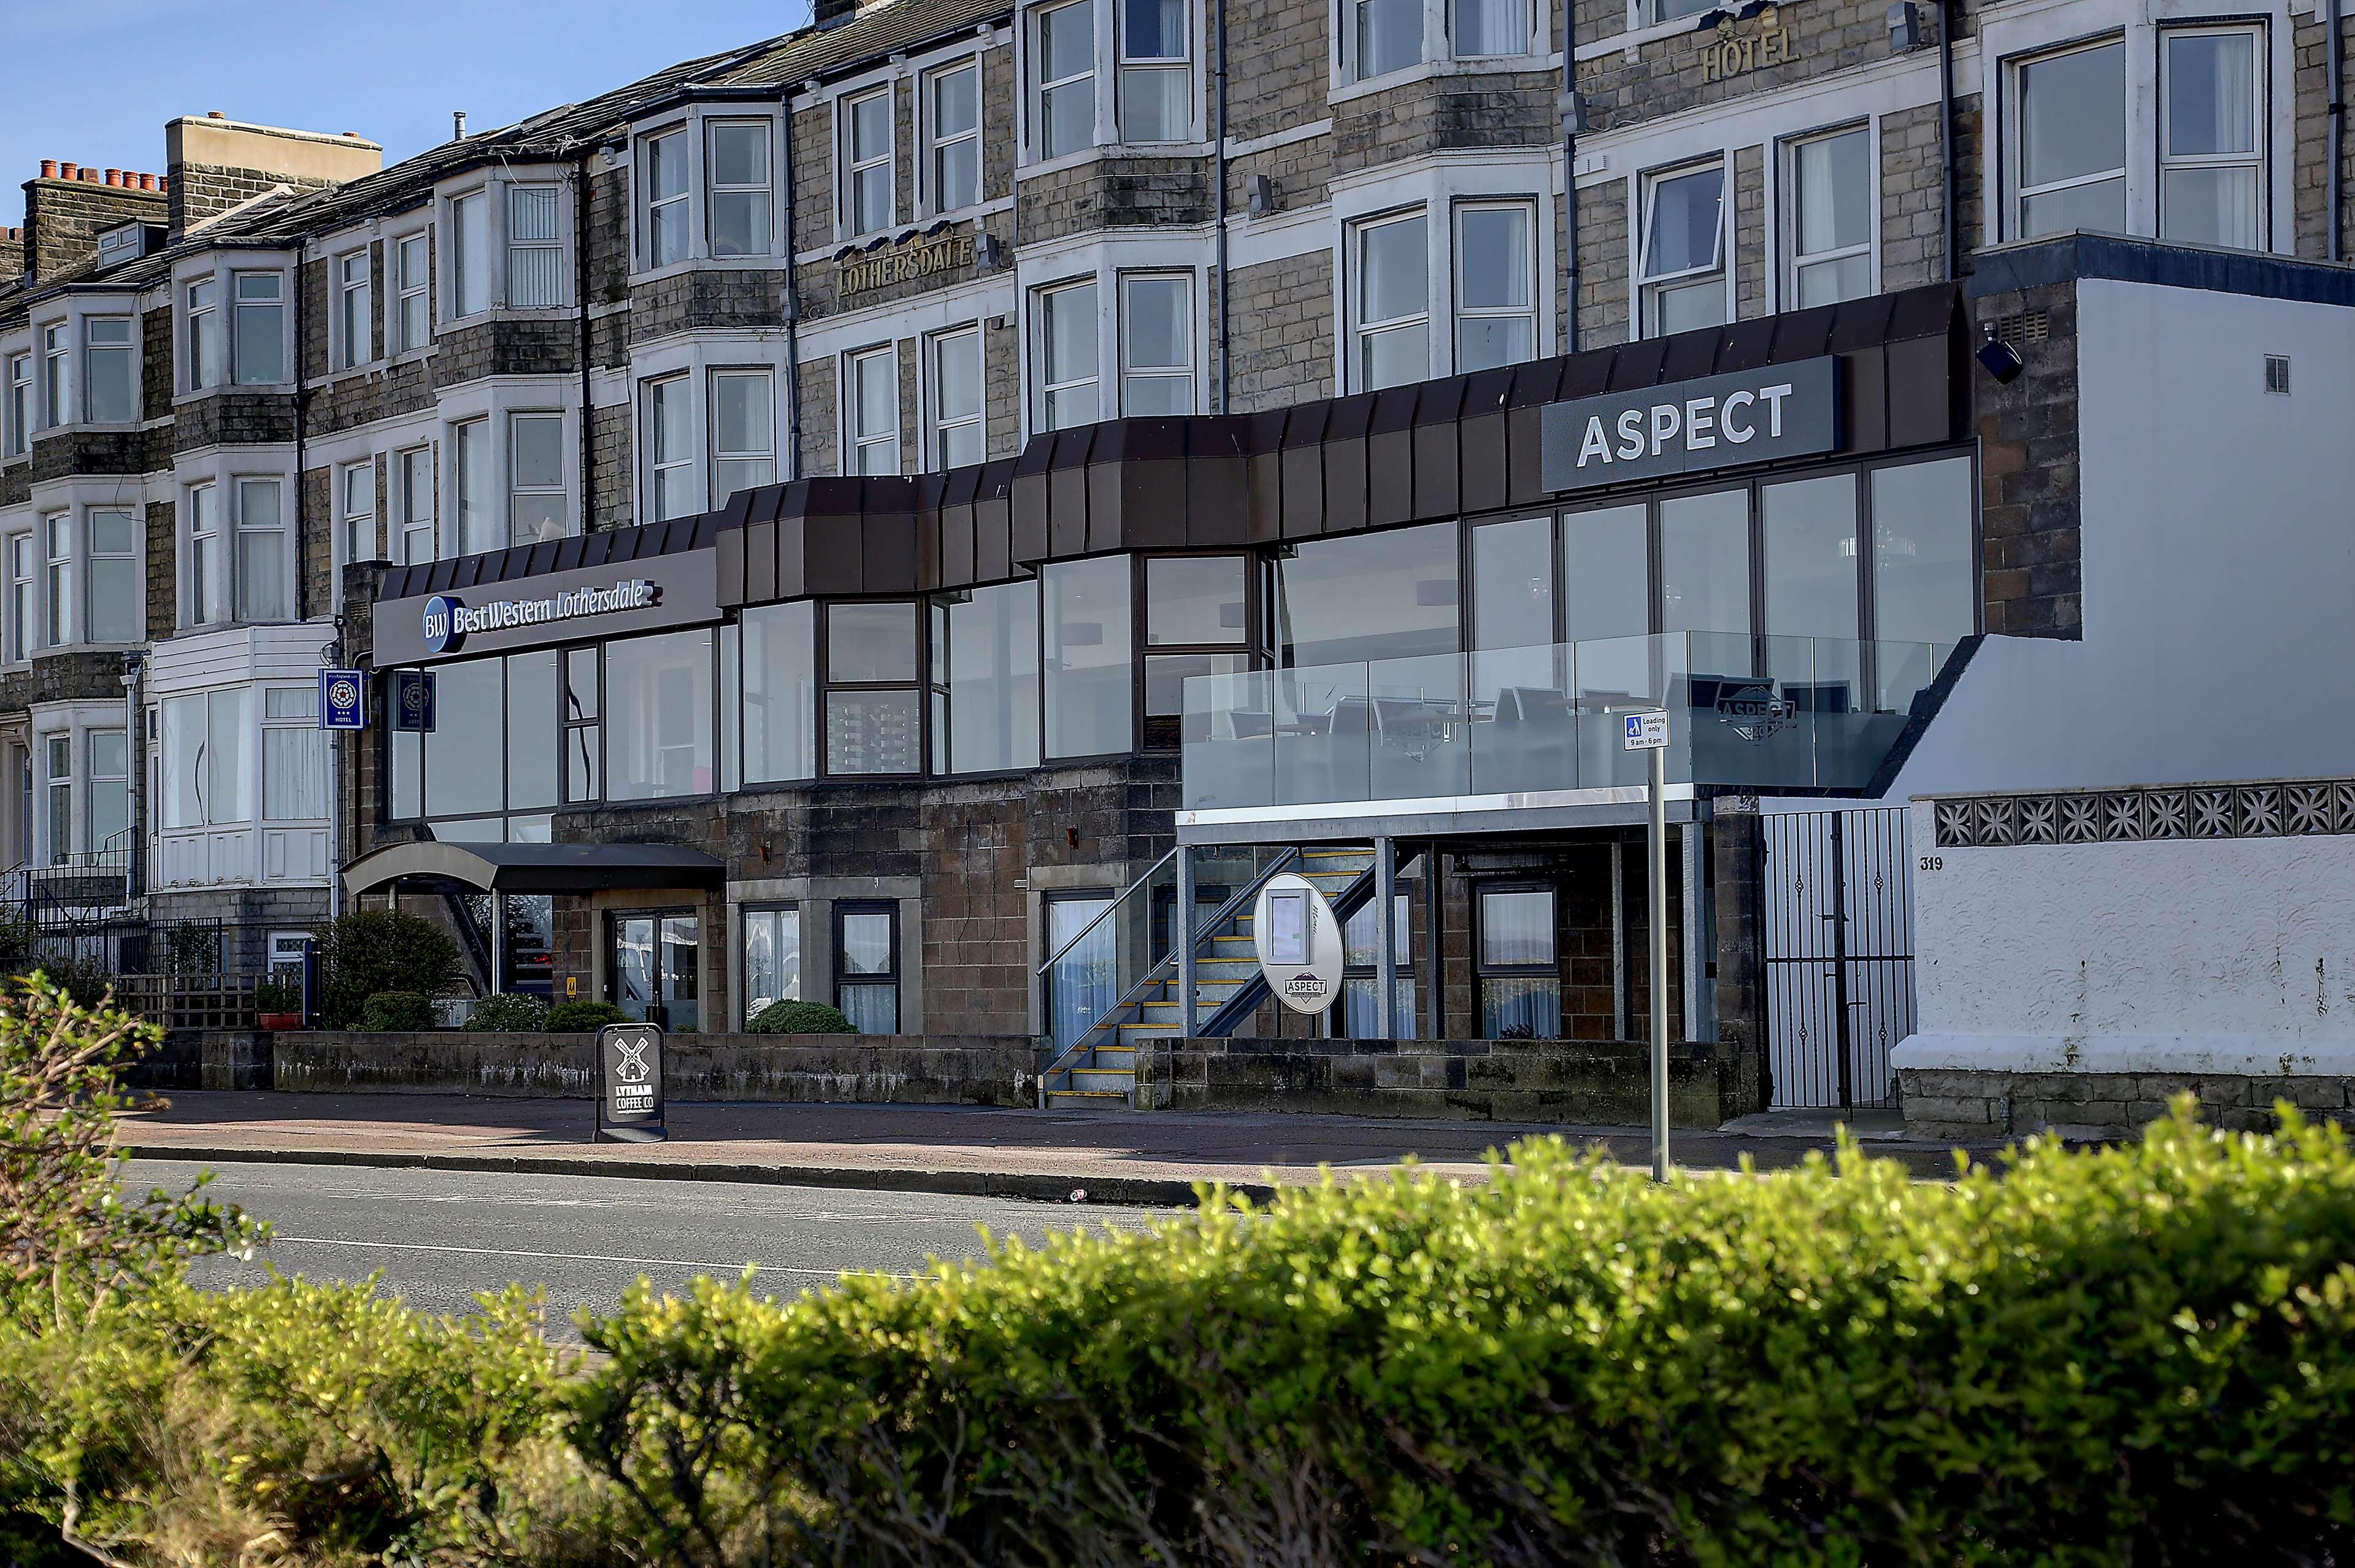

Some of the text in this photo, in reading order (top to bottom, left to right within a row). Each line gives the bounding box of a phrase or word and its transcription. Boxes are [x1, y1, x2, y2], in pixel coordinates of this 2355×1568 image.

[1703, 26, 1800, 82] HOTEL
[838, 237, 974, 296] LOTHERSDALE
[1577, 383, 1792, 467] ASPECT
[425, 614, 447, 639] BW
[454, 582, 643, 634] Best Western Lothersdale
[1920, 856, 1943, 870] 319
[1288, 982, 1324, 991] ASPECT
[616, 1096, 654, 1109] COFFEE CO
